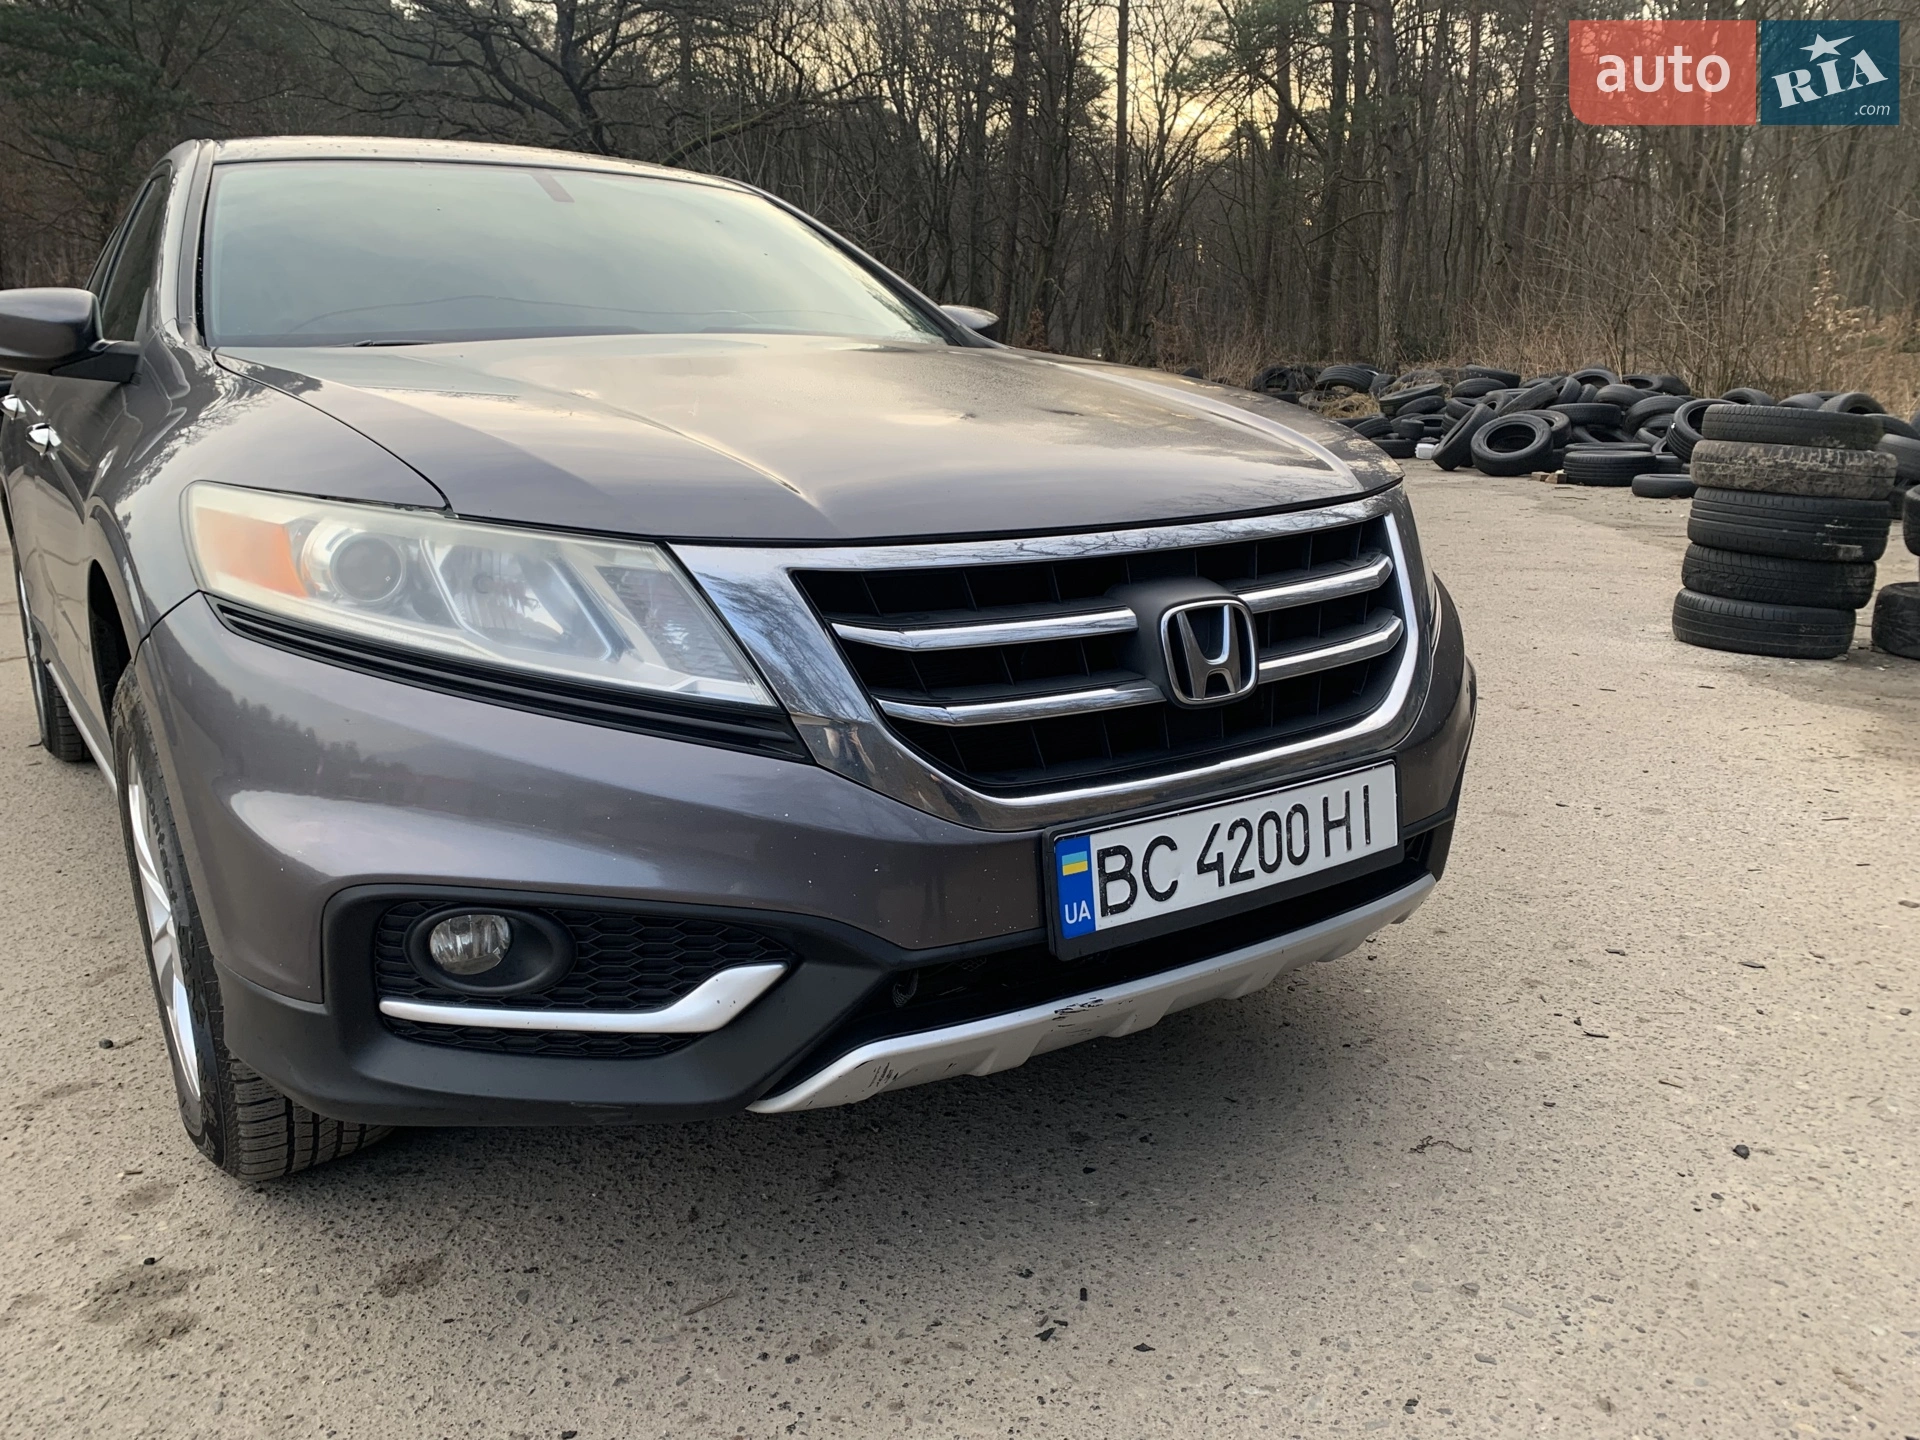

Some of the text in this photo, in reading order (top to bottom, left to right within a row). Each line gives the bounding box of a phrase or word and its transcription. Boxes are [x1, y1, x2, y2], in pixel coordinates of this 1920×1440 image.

[1097, 784, 1371, 918] BC 4200 HI
[1064, 903, 1092, 925] UA
